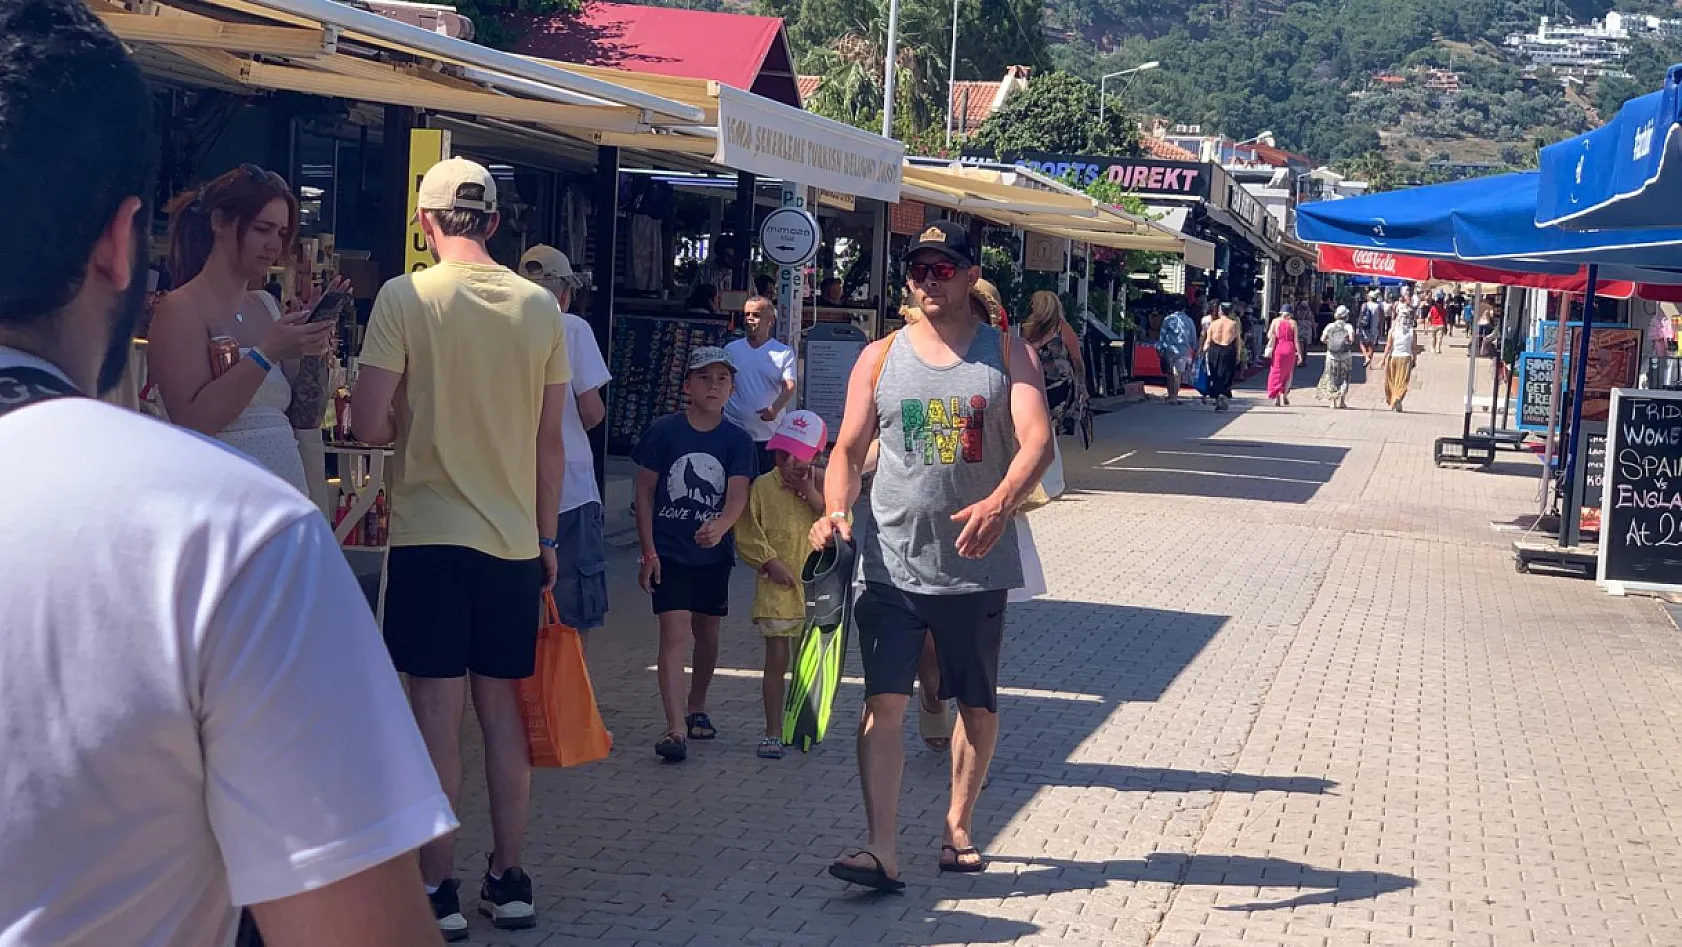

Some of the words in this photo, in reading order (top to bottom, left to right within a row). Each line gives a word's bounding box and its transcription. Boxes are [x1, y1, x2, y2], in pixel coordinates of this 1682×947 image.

[807, 141, 841, 173] TURKISH
[844, 152, 876, 181] DELIGHT
[1108, 165, 1197, 192] DIREKT
[1526, 381, 1547, 393] GET
[1528, 393, 1553, 405] FRE
[1627, 398, 1682, 421] FRID
[659, 506, 690, 520] LONE
[1626, 517, 1653, 547] At
[1655, 511, 1682, 547] 2
